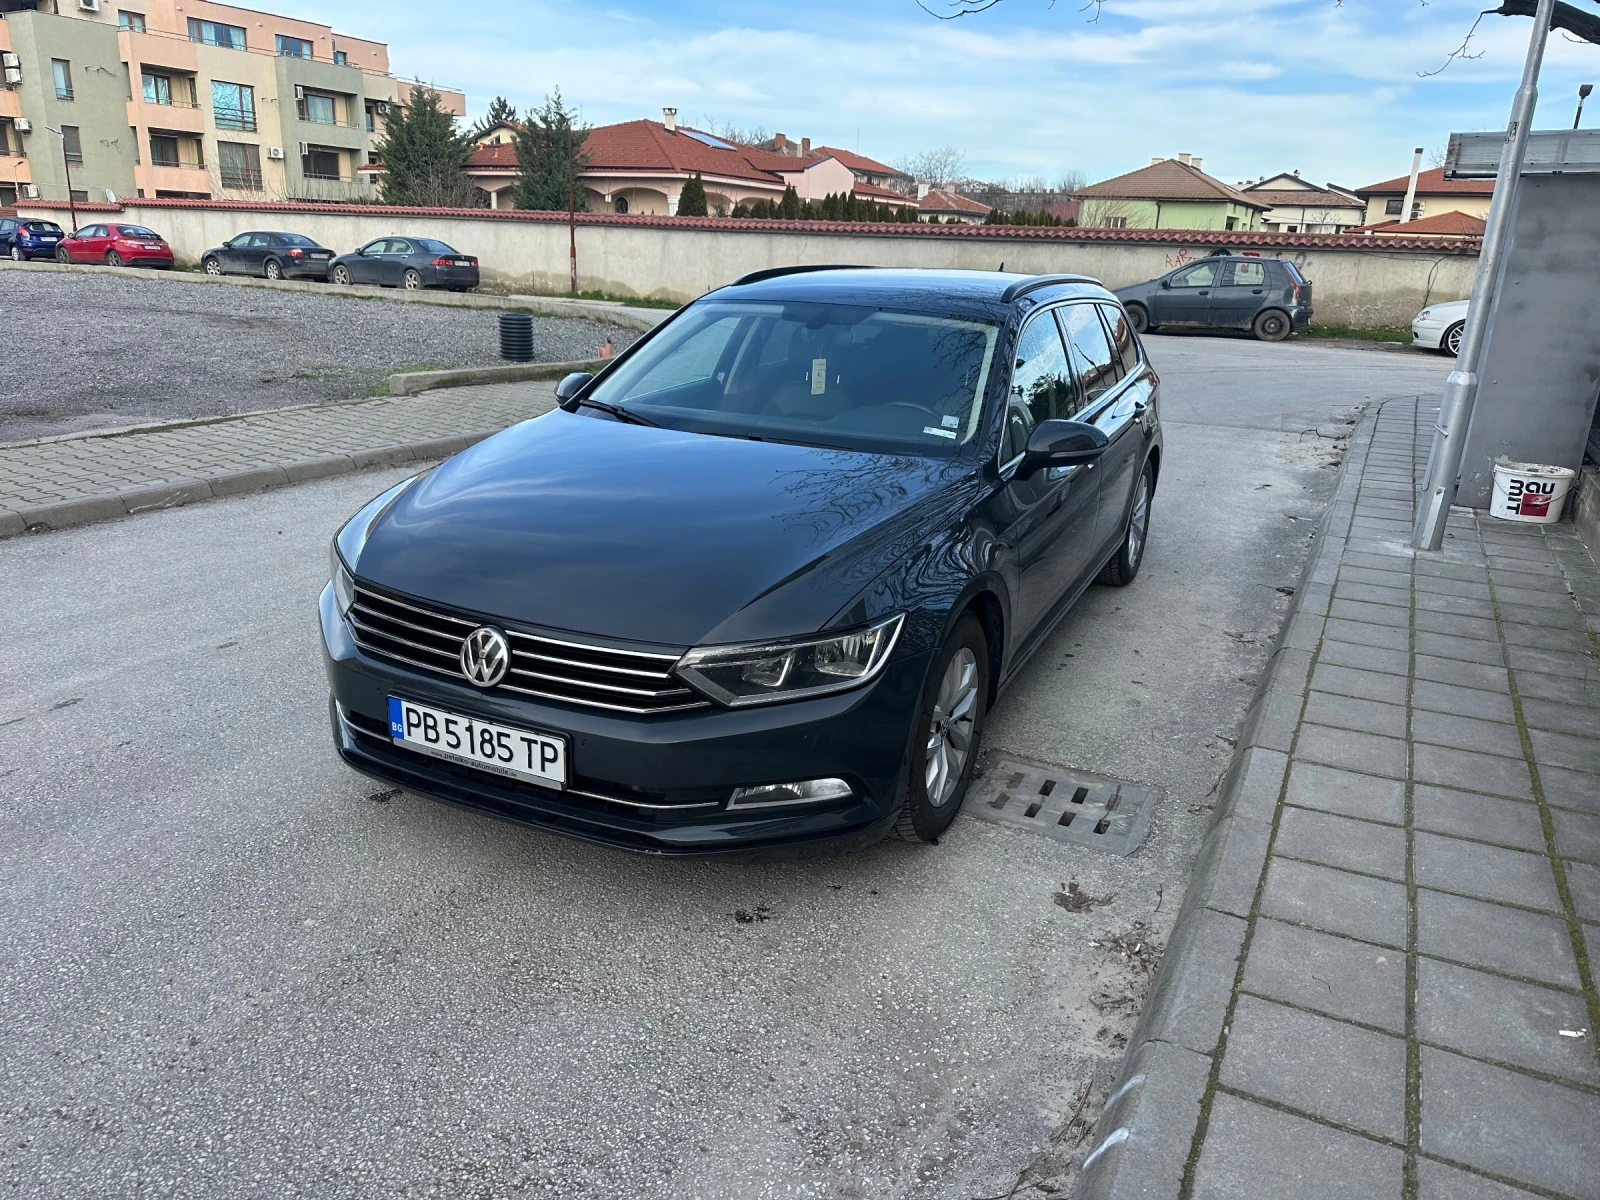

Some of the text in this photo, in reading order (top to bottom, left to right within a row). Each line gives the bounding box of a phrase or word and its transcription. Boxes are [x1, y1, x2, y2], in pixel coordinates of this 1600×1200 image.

[391, 721, 403, 733] BG
[444, 718, 514, 762] 5185
[520, 737, 559, 772] TP
